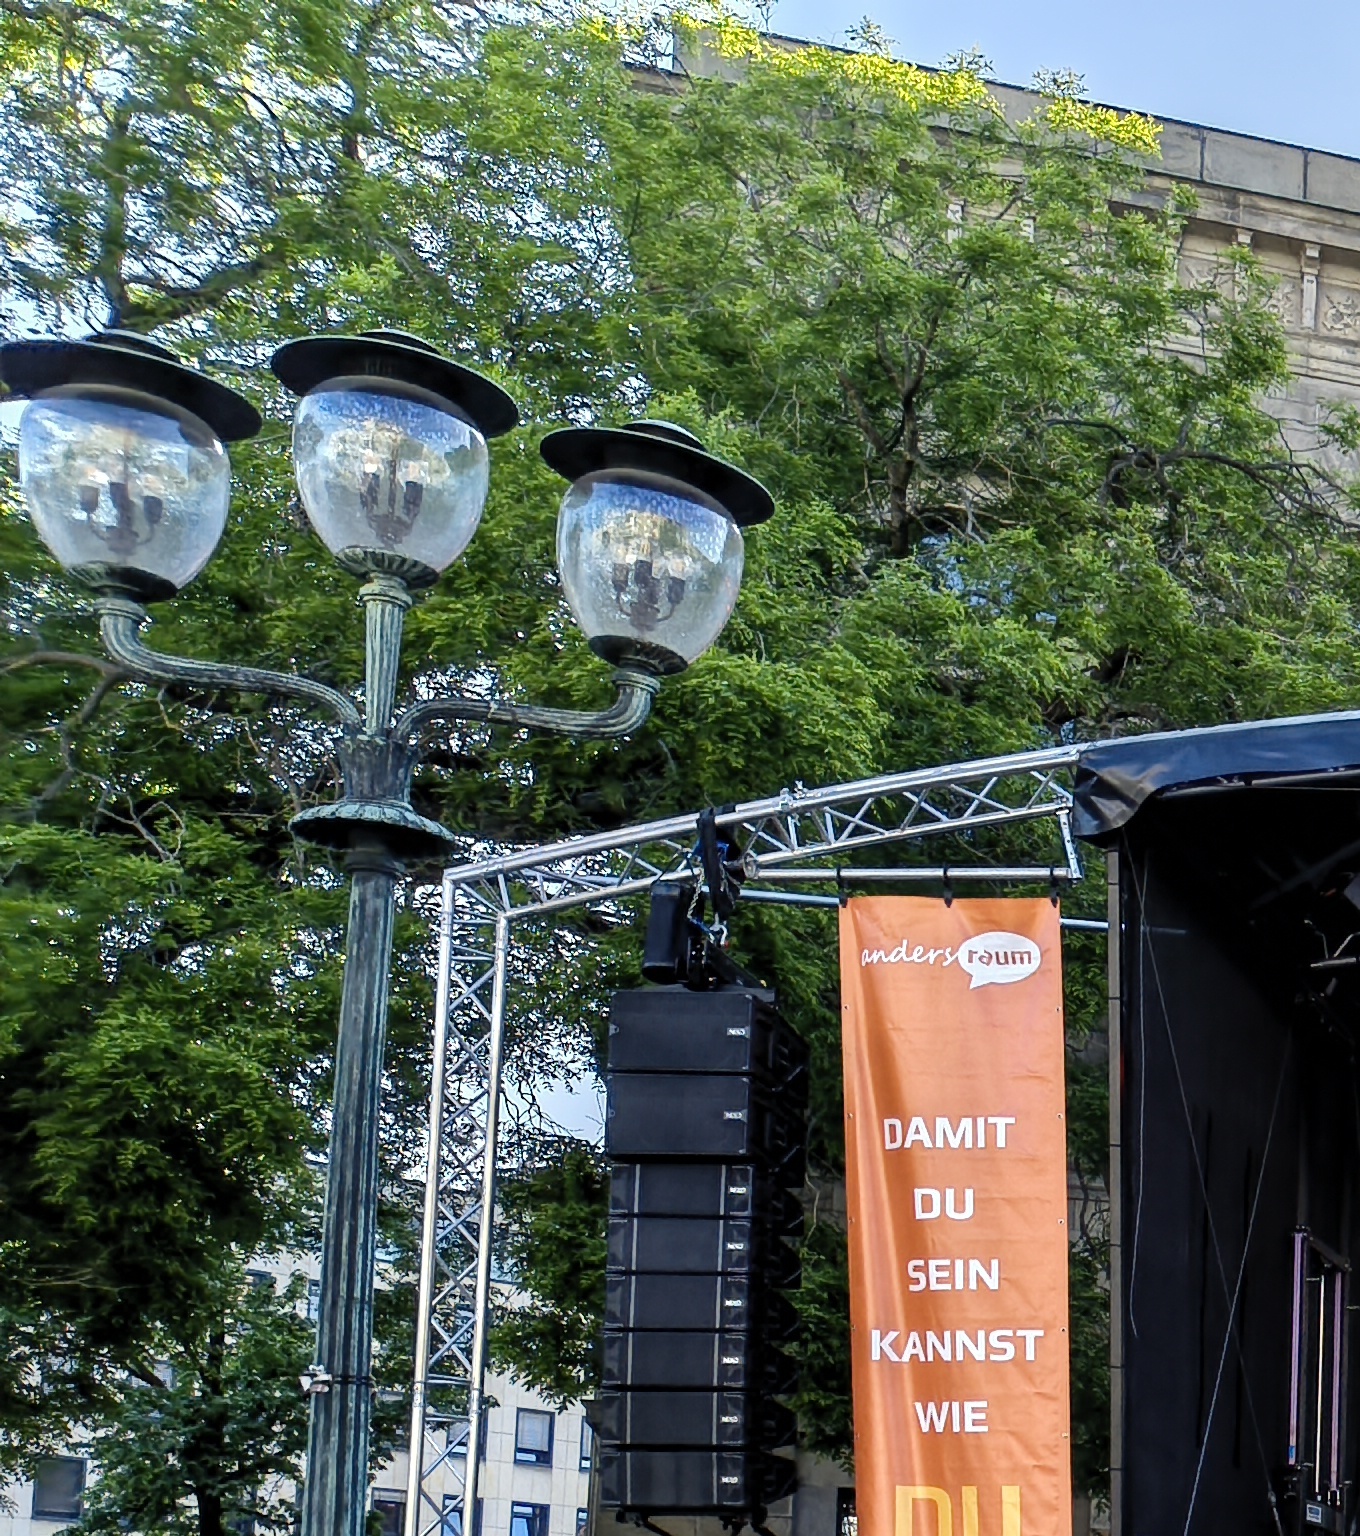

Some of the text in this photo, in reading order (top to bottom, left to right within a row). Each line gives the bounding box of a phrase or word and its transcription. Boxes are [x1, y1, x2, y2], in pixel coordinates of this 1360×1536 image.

[883, 1116, 1016, 1151] DAMIT
[913, 1187, 975, 1221] DU
[907, 1258, 1000, 1292] SEIN
[871, 1329, 1045, 1364] KANNST
[914, 1400, 989, 1433] WIE
